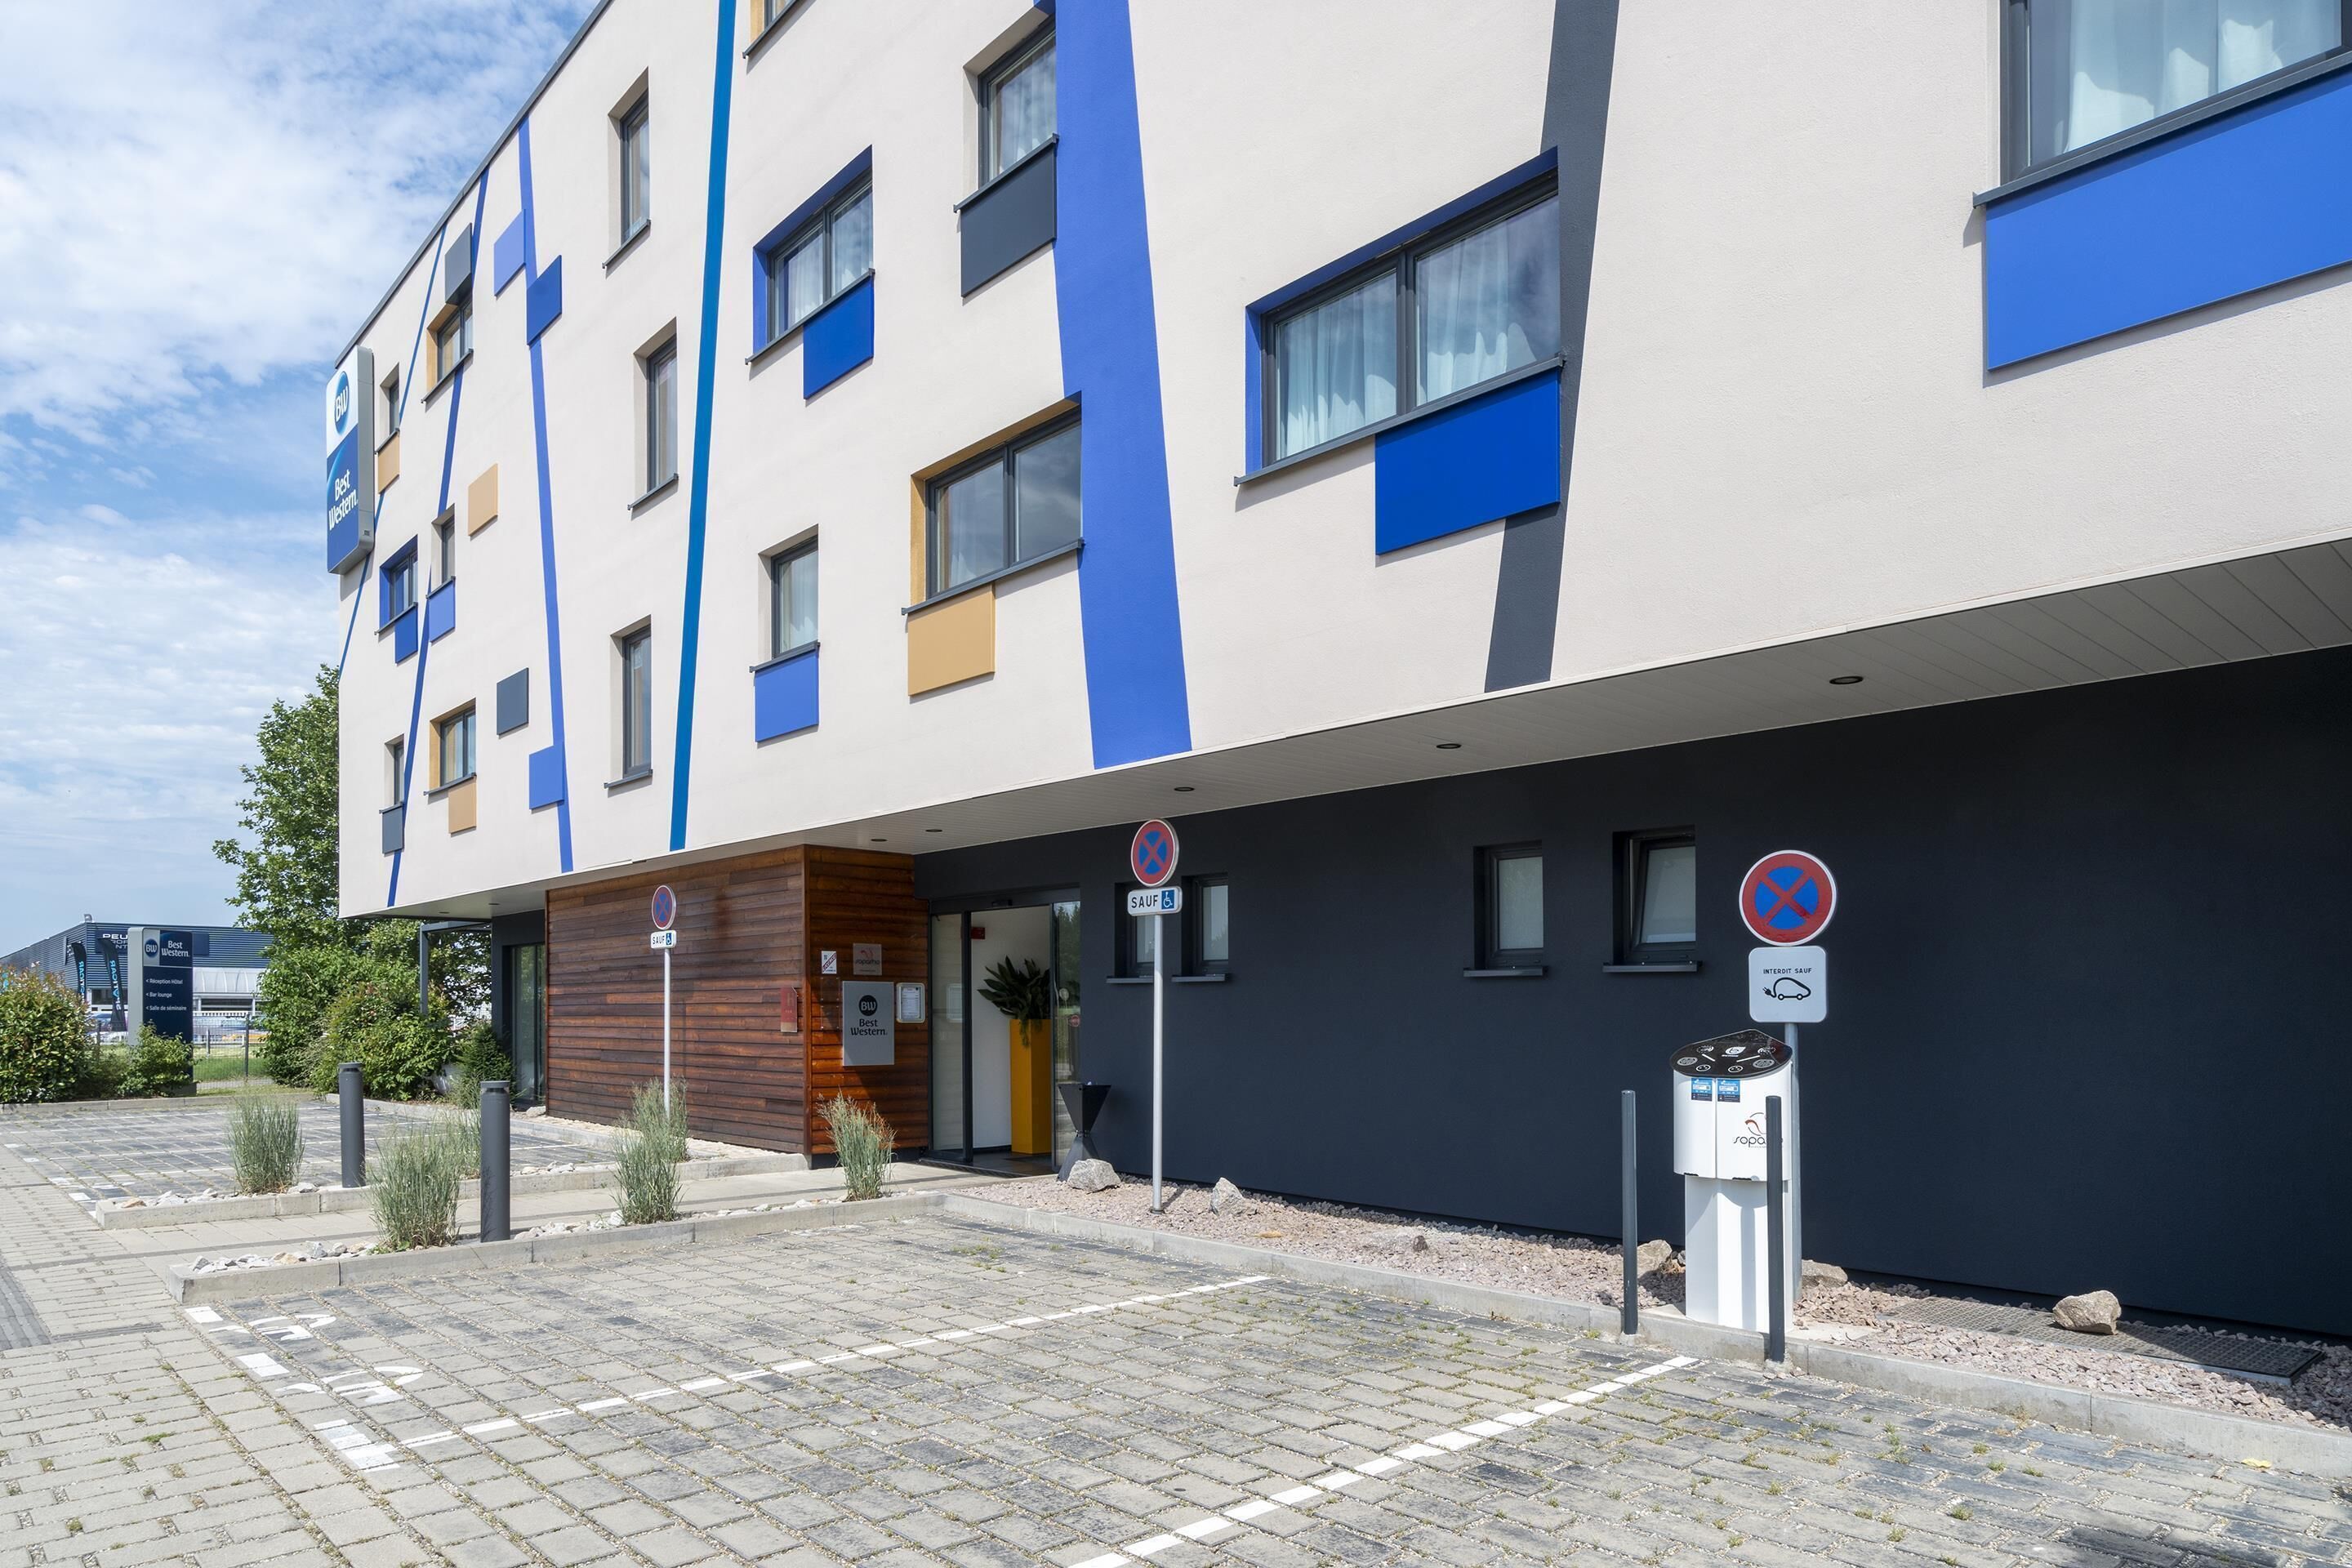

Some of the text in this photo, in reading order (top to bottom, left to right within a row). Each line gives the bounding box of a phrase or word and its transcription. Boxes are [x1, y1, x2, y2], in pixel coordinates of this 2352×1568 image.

[336, 386, 348, 422] BW
[335, 469, 350, 501] Best
[328, 489, 357, 531] Western
[1131, 894, 1159, 909] SAUF
[167, 940, 183, 949] Best
[653, 935, 666, 945] SAUF
[145, 944, 158, 953] BW
[161, 948, 189, 957] Western
[861, 1001, 876, 1011] BW
[859, 1018, 878, 1027] Best
[850, 1027, 886, 1036] Western
